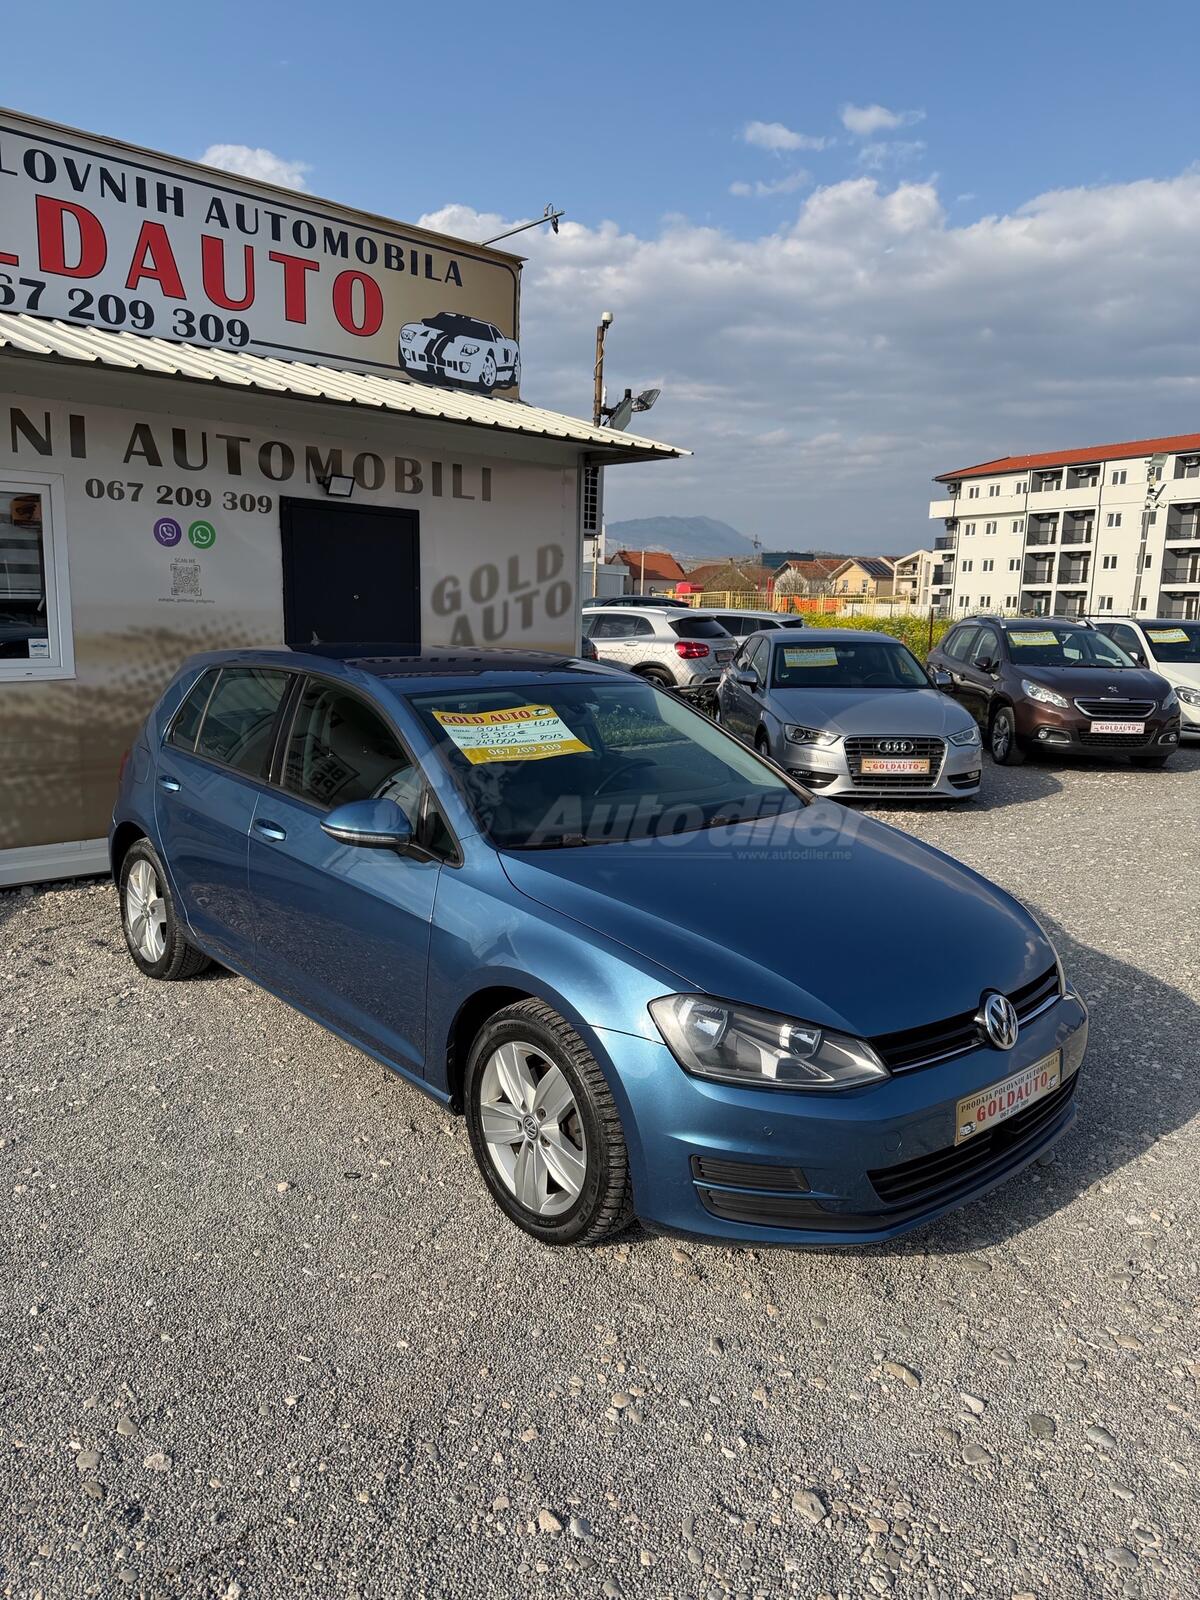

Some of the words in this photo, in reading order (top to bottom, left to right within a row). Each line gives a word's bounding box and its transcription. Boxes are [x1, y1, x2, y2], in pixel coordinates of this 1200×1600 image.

[205, 197, 463, 287] AUTOMOBILA
[68, 288, 155, 329] 209
[173, 308, 250, 347] 309
[10, 407, 87, 458] NI
[123, 423, 492, 502] AUTOMOBILI
[85, 478, 143, 502] 067
[156, 485, 212, 508] 209
[222, 491, 273, 514] 309
[431, 544, 564, 617] GOLD
[450, 580, 572, 647] AUTO
[441, 715, 485, 724] GOLD
[490, 711, 531, 722] AUTO
[540, 733, 563, 741] 2013
[488, 747, 509, 756] 067
[516, 745, 536, 753] 209
[540, 743, 561, 752] 309
[961, 1093, 992, 1112] PRODAJA
[994, 1075, 1024, 1098] POLOVNIH
[976, 1071, 1047, 1122] GOLDAUTO
